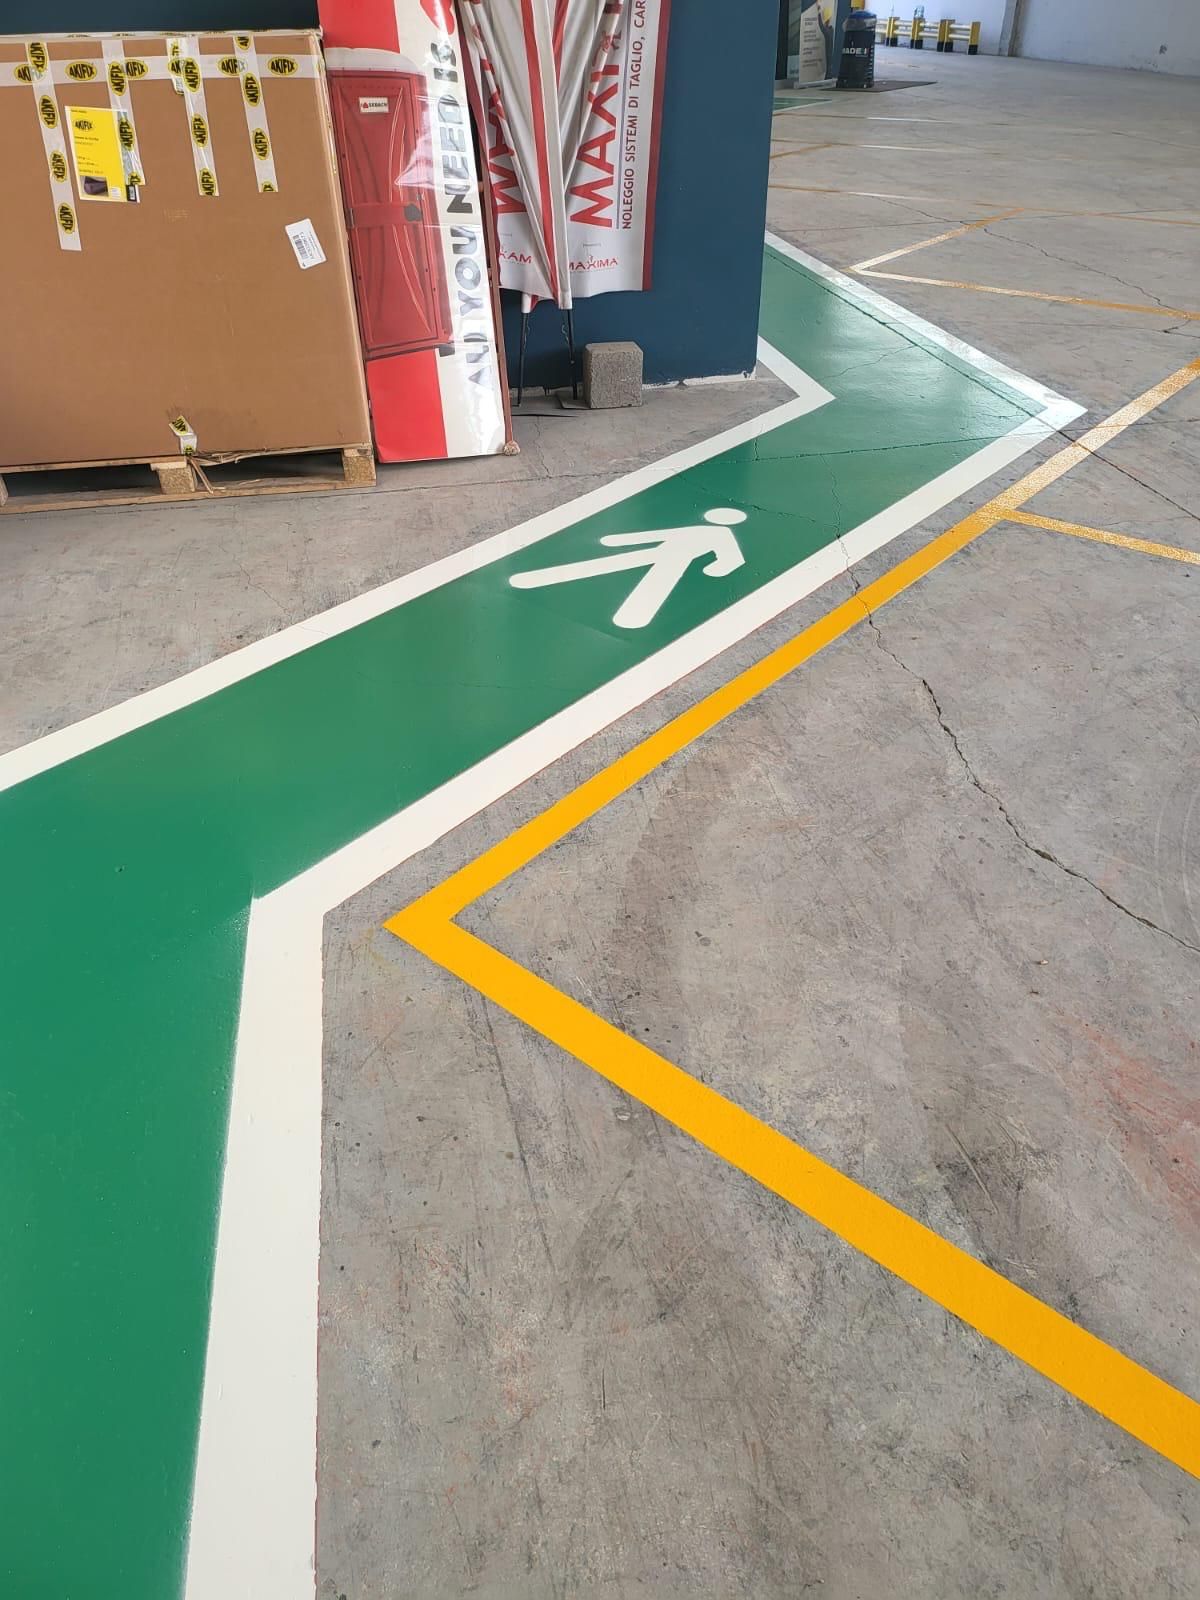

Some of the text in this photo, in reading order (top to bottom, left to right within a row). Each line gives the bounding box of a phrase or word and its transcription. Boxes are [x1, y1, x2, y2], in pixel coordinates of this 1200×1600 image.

[69, 63, 95, 79] AKIFIX
[184, 60, 199, 89] AKIFIX
[270, 58, 295, 74] AKIFIX
[430, 42, 458, 83] IS
[630, 36, 646, 90] TAGLIO,
[110, 65, 125, 93] AKIFIX
[245, 76, 259, 104] AKIFIX
[41, 98, 56, 126] AKIFIX
[628, 96, 639, 109] DI
[75, 119, 93, 131] AKIFIX
[193, 117, 207, 145] AKIFIX
[625, 113, 638, 162] SISTEMI
[254, 131, 268, 158] AKIFIX
[437, 95, 473, 214] NEED
[52, 153, 66, 179] AKIFIX
[622, 169, 635, 229] NOLEGGIO
[60, 204, 74, 230] AKIFIX
[450, 226, 484, 316] YOU
